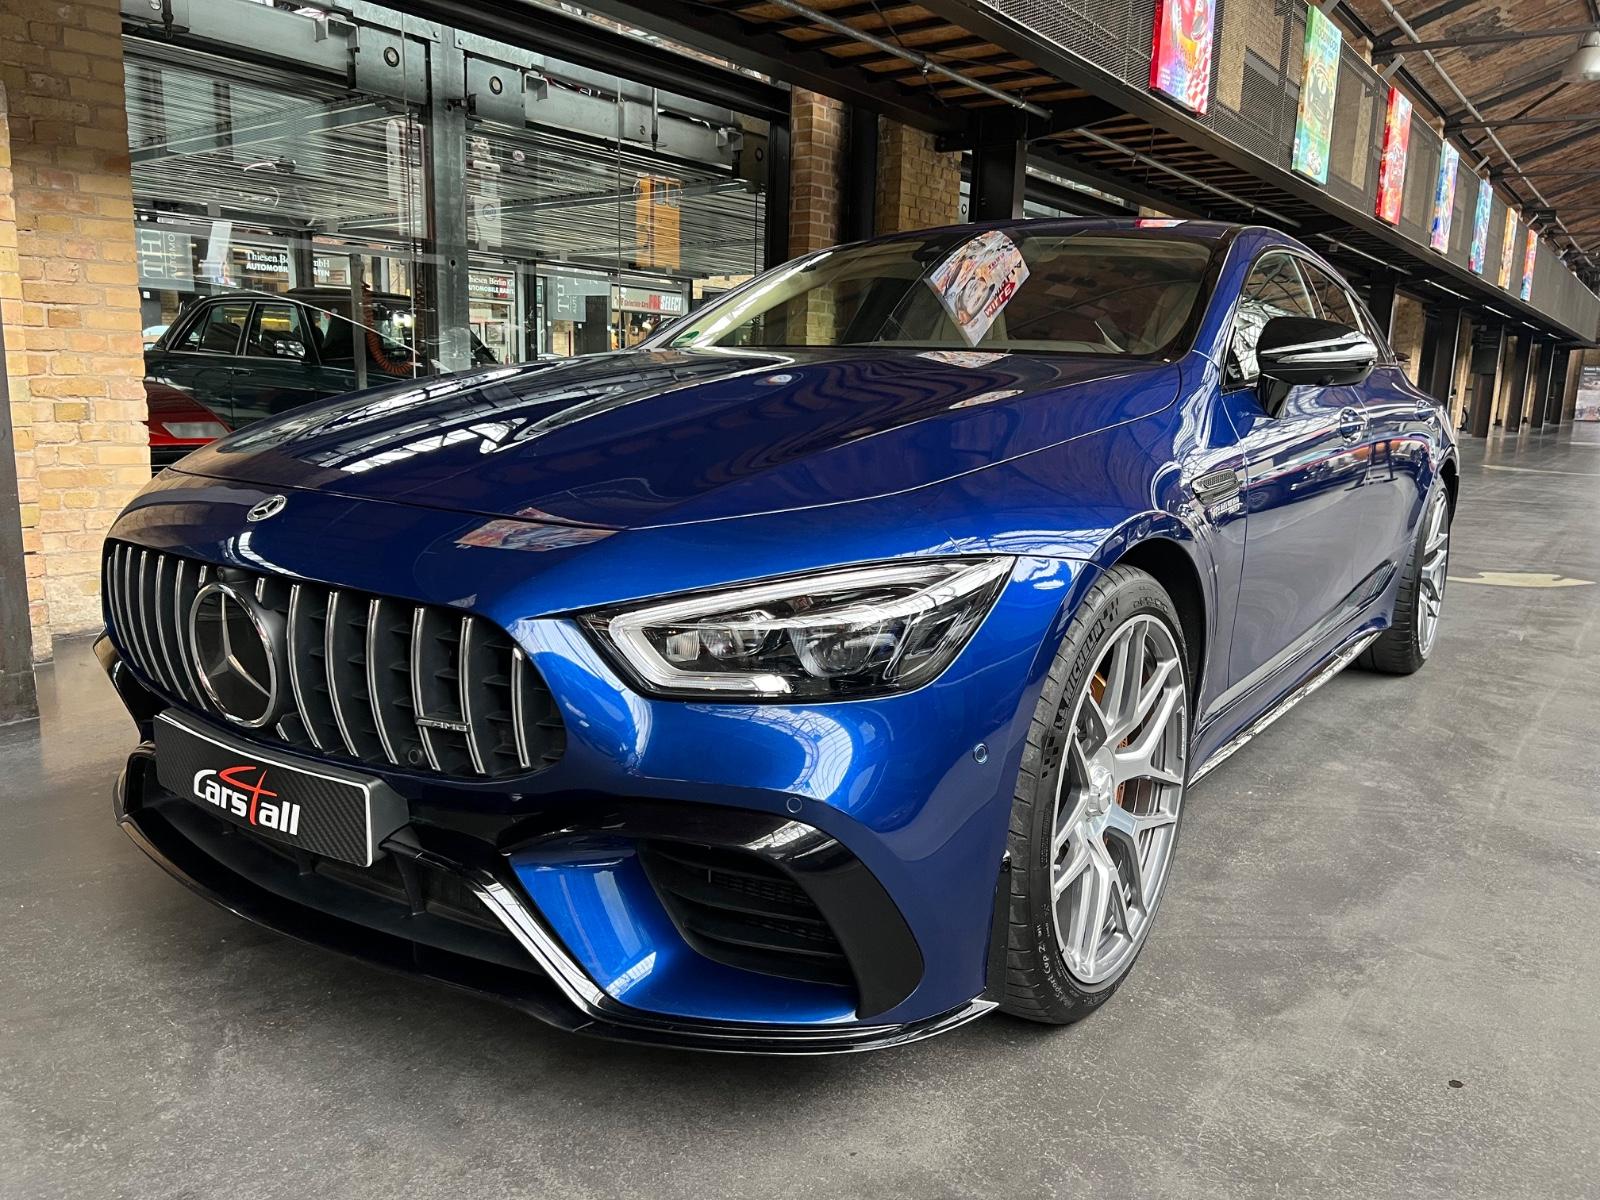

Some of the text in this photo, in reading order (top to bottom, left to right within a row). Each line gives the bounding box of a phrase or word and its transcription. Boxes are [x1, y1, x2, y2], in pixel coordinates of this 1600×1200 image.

[468, 274, 488, 284] hiesen
[1062, 619, 1106, 707] MICHELIN
[433, 722, 468, 732] AMG
[1043, 955, 1051, 974] Cup
[1048, 974, 1063, 998] Sport
